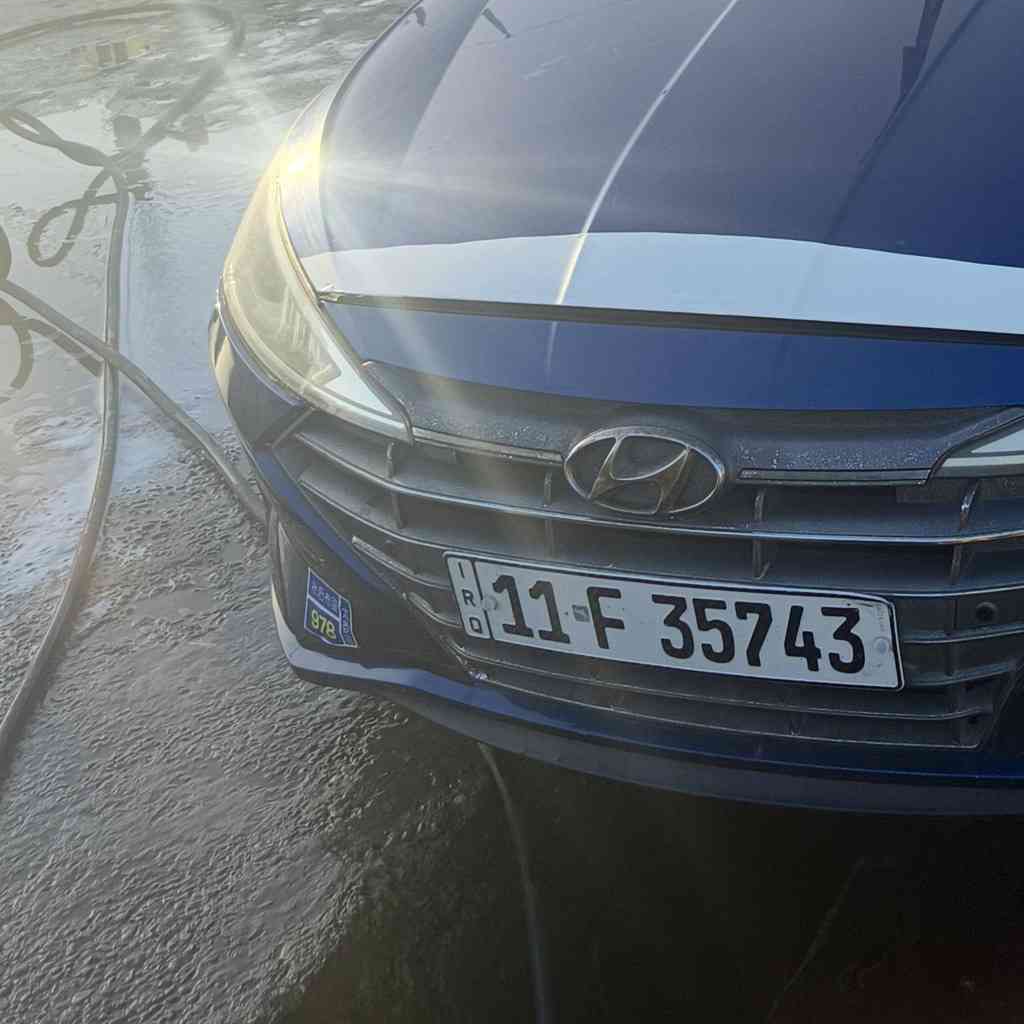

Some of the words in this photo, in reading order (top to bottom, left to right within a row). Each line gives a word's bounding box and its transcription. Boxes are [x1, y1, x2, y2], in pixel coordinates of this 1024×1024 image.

[492, 574, 570, 644] 11
[586, 587, 625, 650] F
[651, 594, 865, 674] 35743
